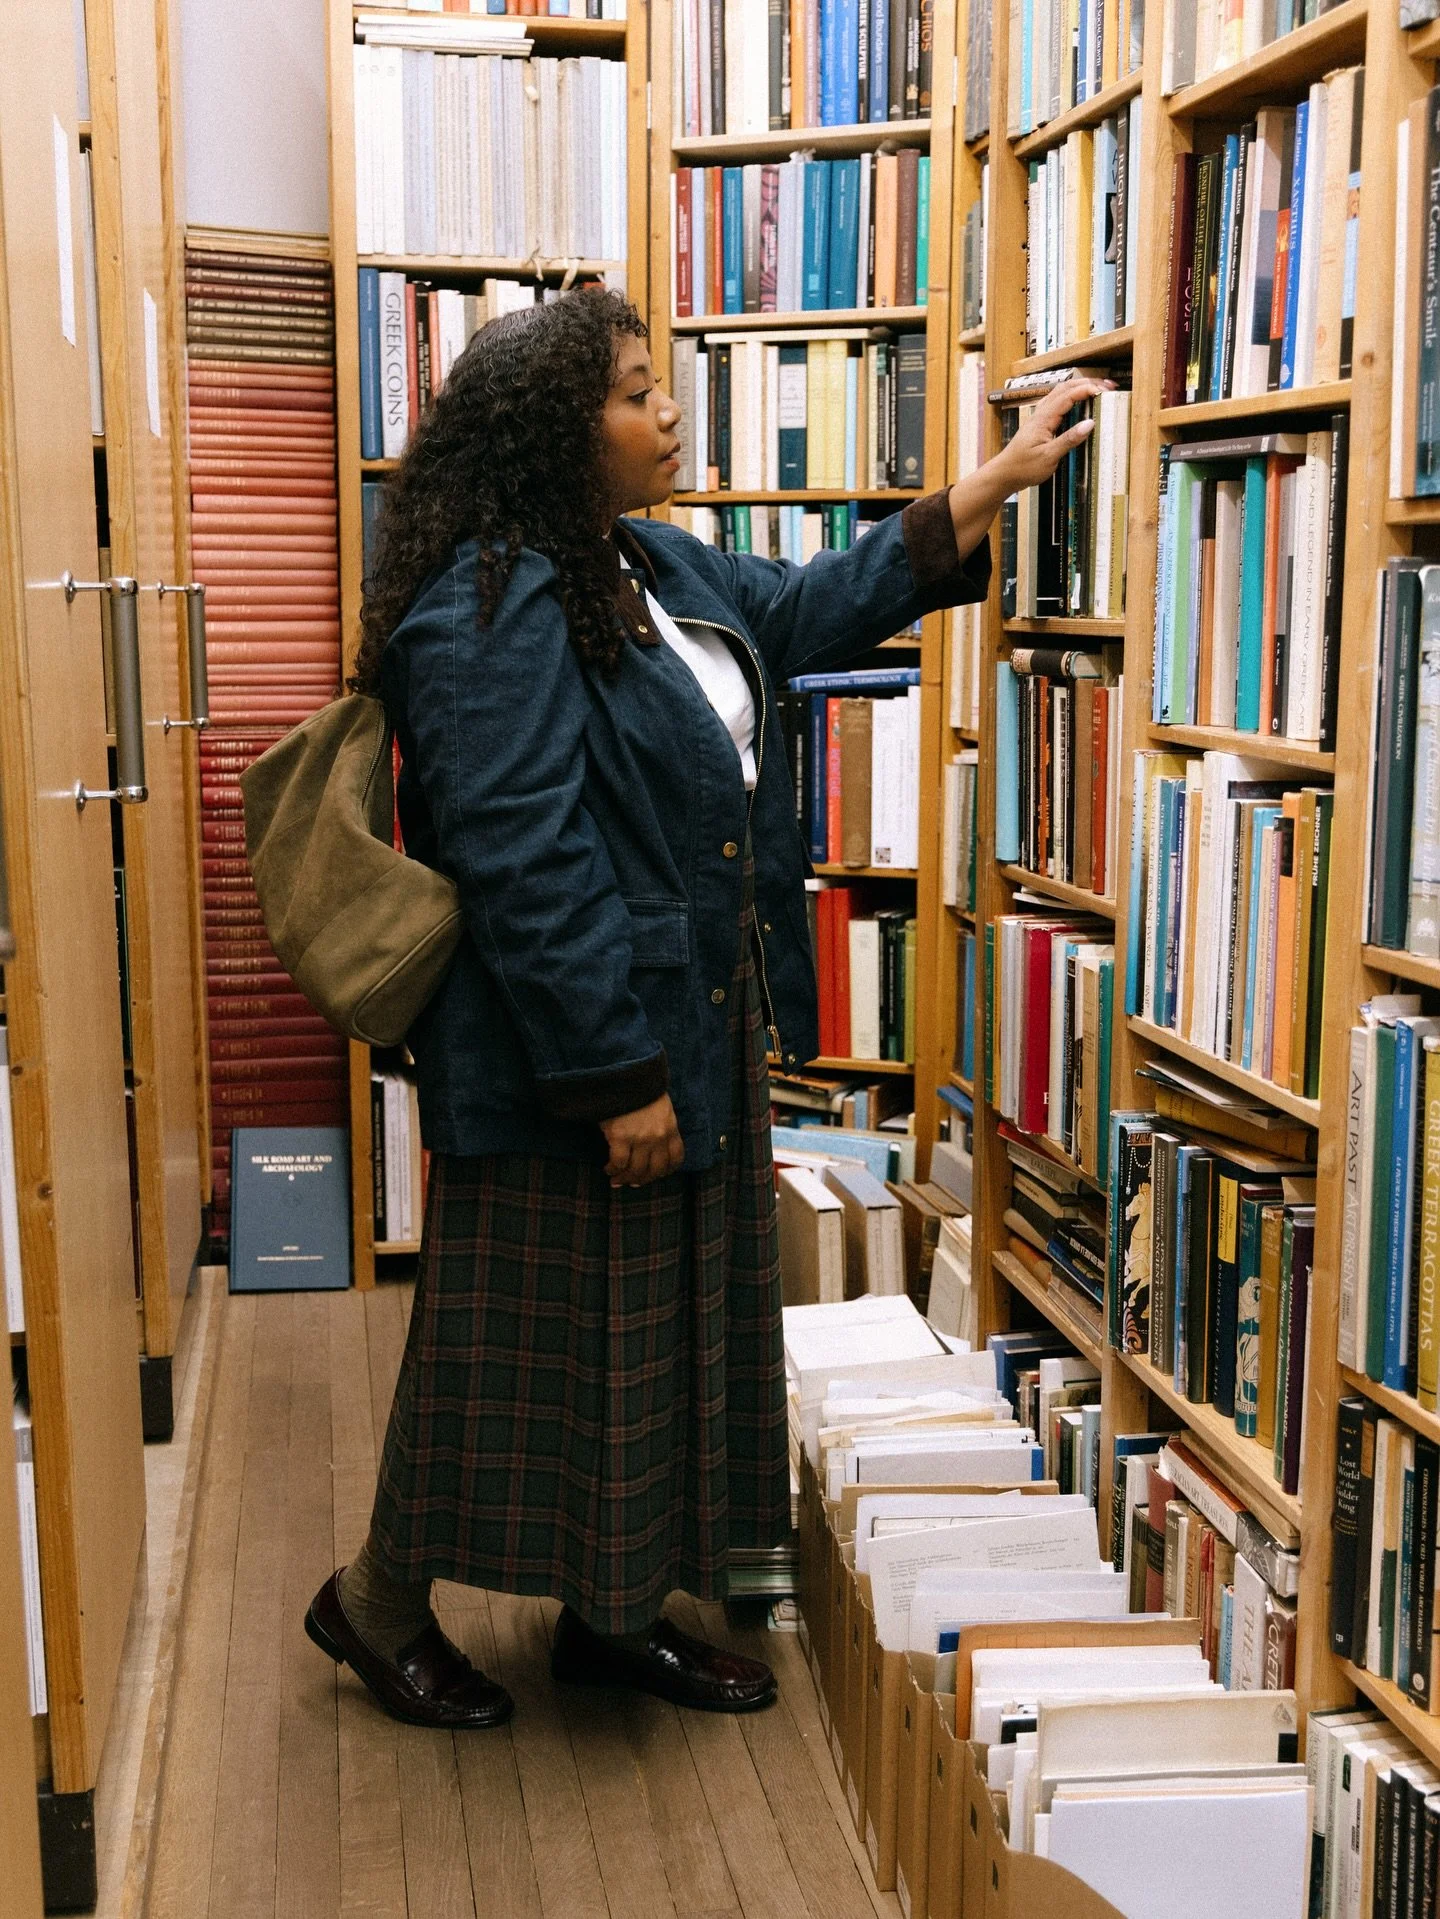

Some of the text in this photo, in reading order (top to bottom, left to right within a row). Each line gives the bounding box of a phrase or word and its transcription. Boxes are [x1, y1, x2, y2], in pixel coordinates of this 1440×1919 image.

[875, 19, 884, 64] Boundaries
[920, 0, 934, 52] CHIOS
[858, 28, 866, 80] SCULPTURE
[1296, 112, 1304, 135] Enid
[1200, 164, 1208, 204] BONFIRE
[1221, 169, 1229, 219] Archaeology
[1290, 176, 1302, 250] XANTHUS
[1425, 165, 1440, 348] The Centaur's Smile
[1194, 249, 1203, 308] HUMANITIES
[385, 292, 404, 426] GREEK COINS
[680, 362, 690, 396] FACES
[680, 400, 690, 416] OF
[1331, 432, 1339, 451] Drink
[1298, 436, 1318, 734] MYTH AND LEGEND IN EARLY GREEK ART
[1398, 674, 1406, 703] GREEK
[1395, 703, 1404, 760] CIVILIZATION
[1312, 853, 1320, 888] FRÜHE
[252, 1156, 332, 1164] SILK ROAD ART AND
[262, 1164, 324, 1172] ARCHAEOLOGY
[1396, 1156, 1402, 1166] LA
[1343, 1070, 1362, 1294] ART PAST ART PRESENT
[1394, 1168, 1402, 1197] FIGURA
[1420, 1100, 1440, 1351] GREEK TERRACOTTAS
[1338, 1465, 1360, 1480] World
[1340, 1456, 1356, 1468] Lost
[1113, 1483, 1122, 1510] The
[1190, 1486, 1202, 1504] ART
[1338, 1498, 1355, 1514] King
[1421, 1531, 1426, 1542] IN
[1243, 1604, 1255, 1657] THE
[1416, 1595, 1424, 1652] ARCHAEOLOGY
[1266, 1626, 1282, 1690] CRETE
[1408, 1834, 1416, 1880] KYKLADEN
[1424, 1873, 1434, 1888] of
